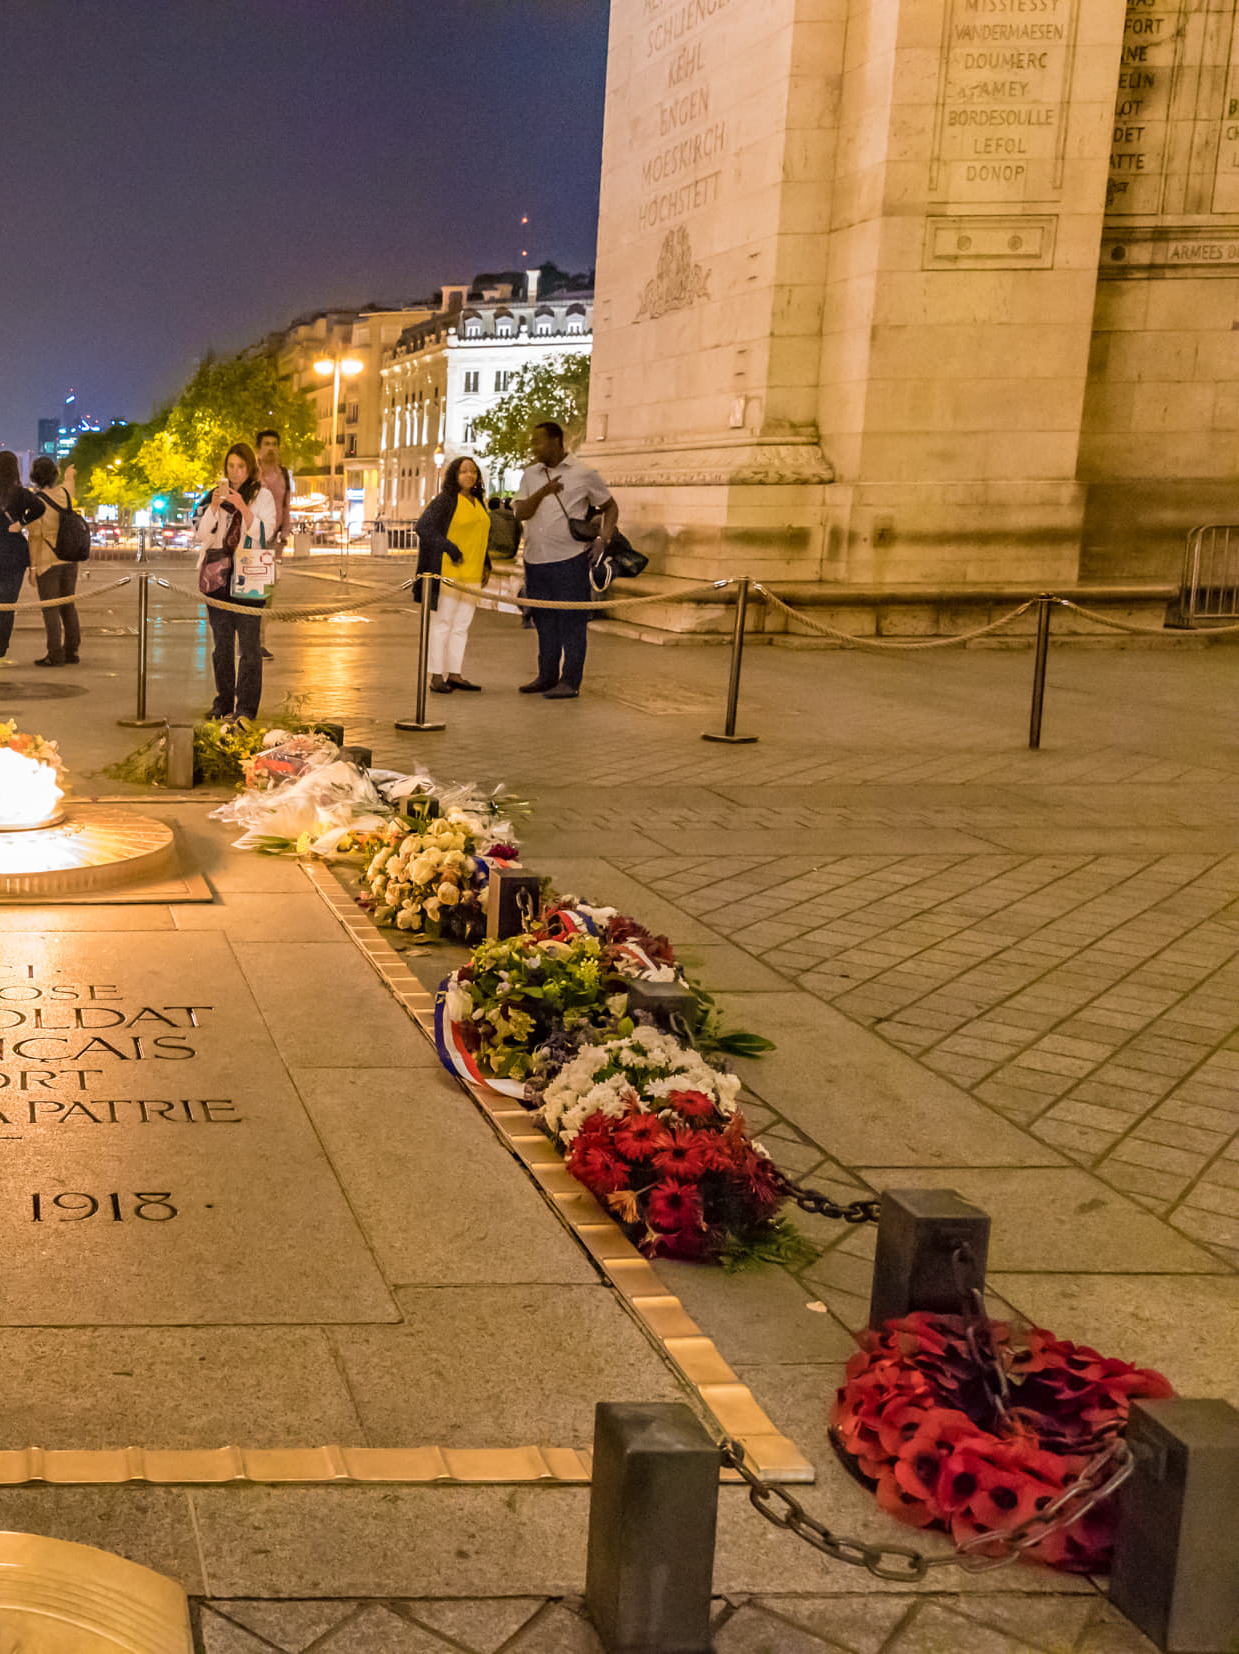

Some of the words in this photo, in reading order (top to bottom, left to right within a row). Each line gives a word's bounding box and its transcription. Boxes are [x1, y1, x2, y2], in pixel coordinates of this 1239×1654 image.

[955, 24, 1064, 41] VANDERMAESEN
[964, 52, 1049, 70] DOUMERC
[948, 109, 1055, 126] BORDESOULLE
[974, 138, 1026, 154] LEFOL
[966, 165, 1025, 181] DONOP
[28, 1099, 243, 1124] PATRIE
[31, 1191, 179, 1223] 1918
